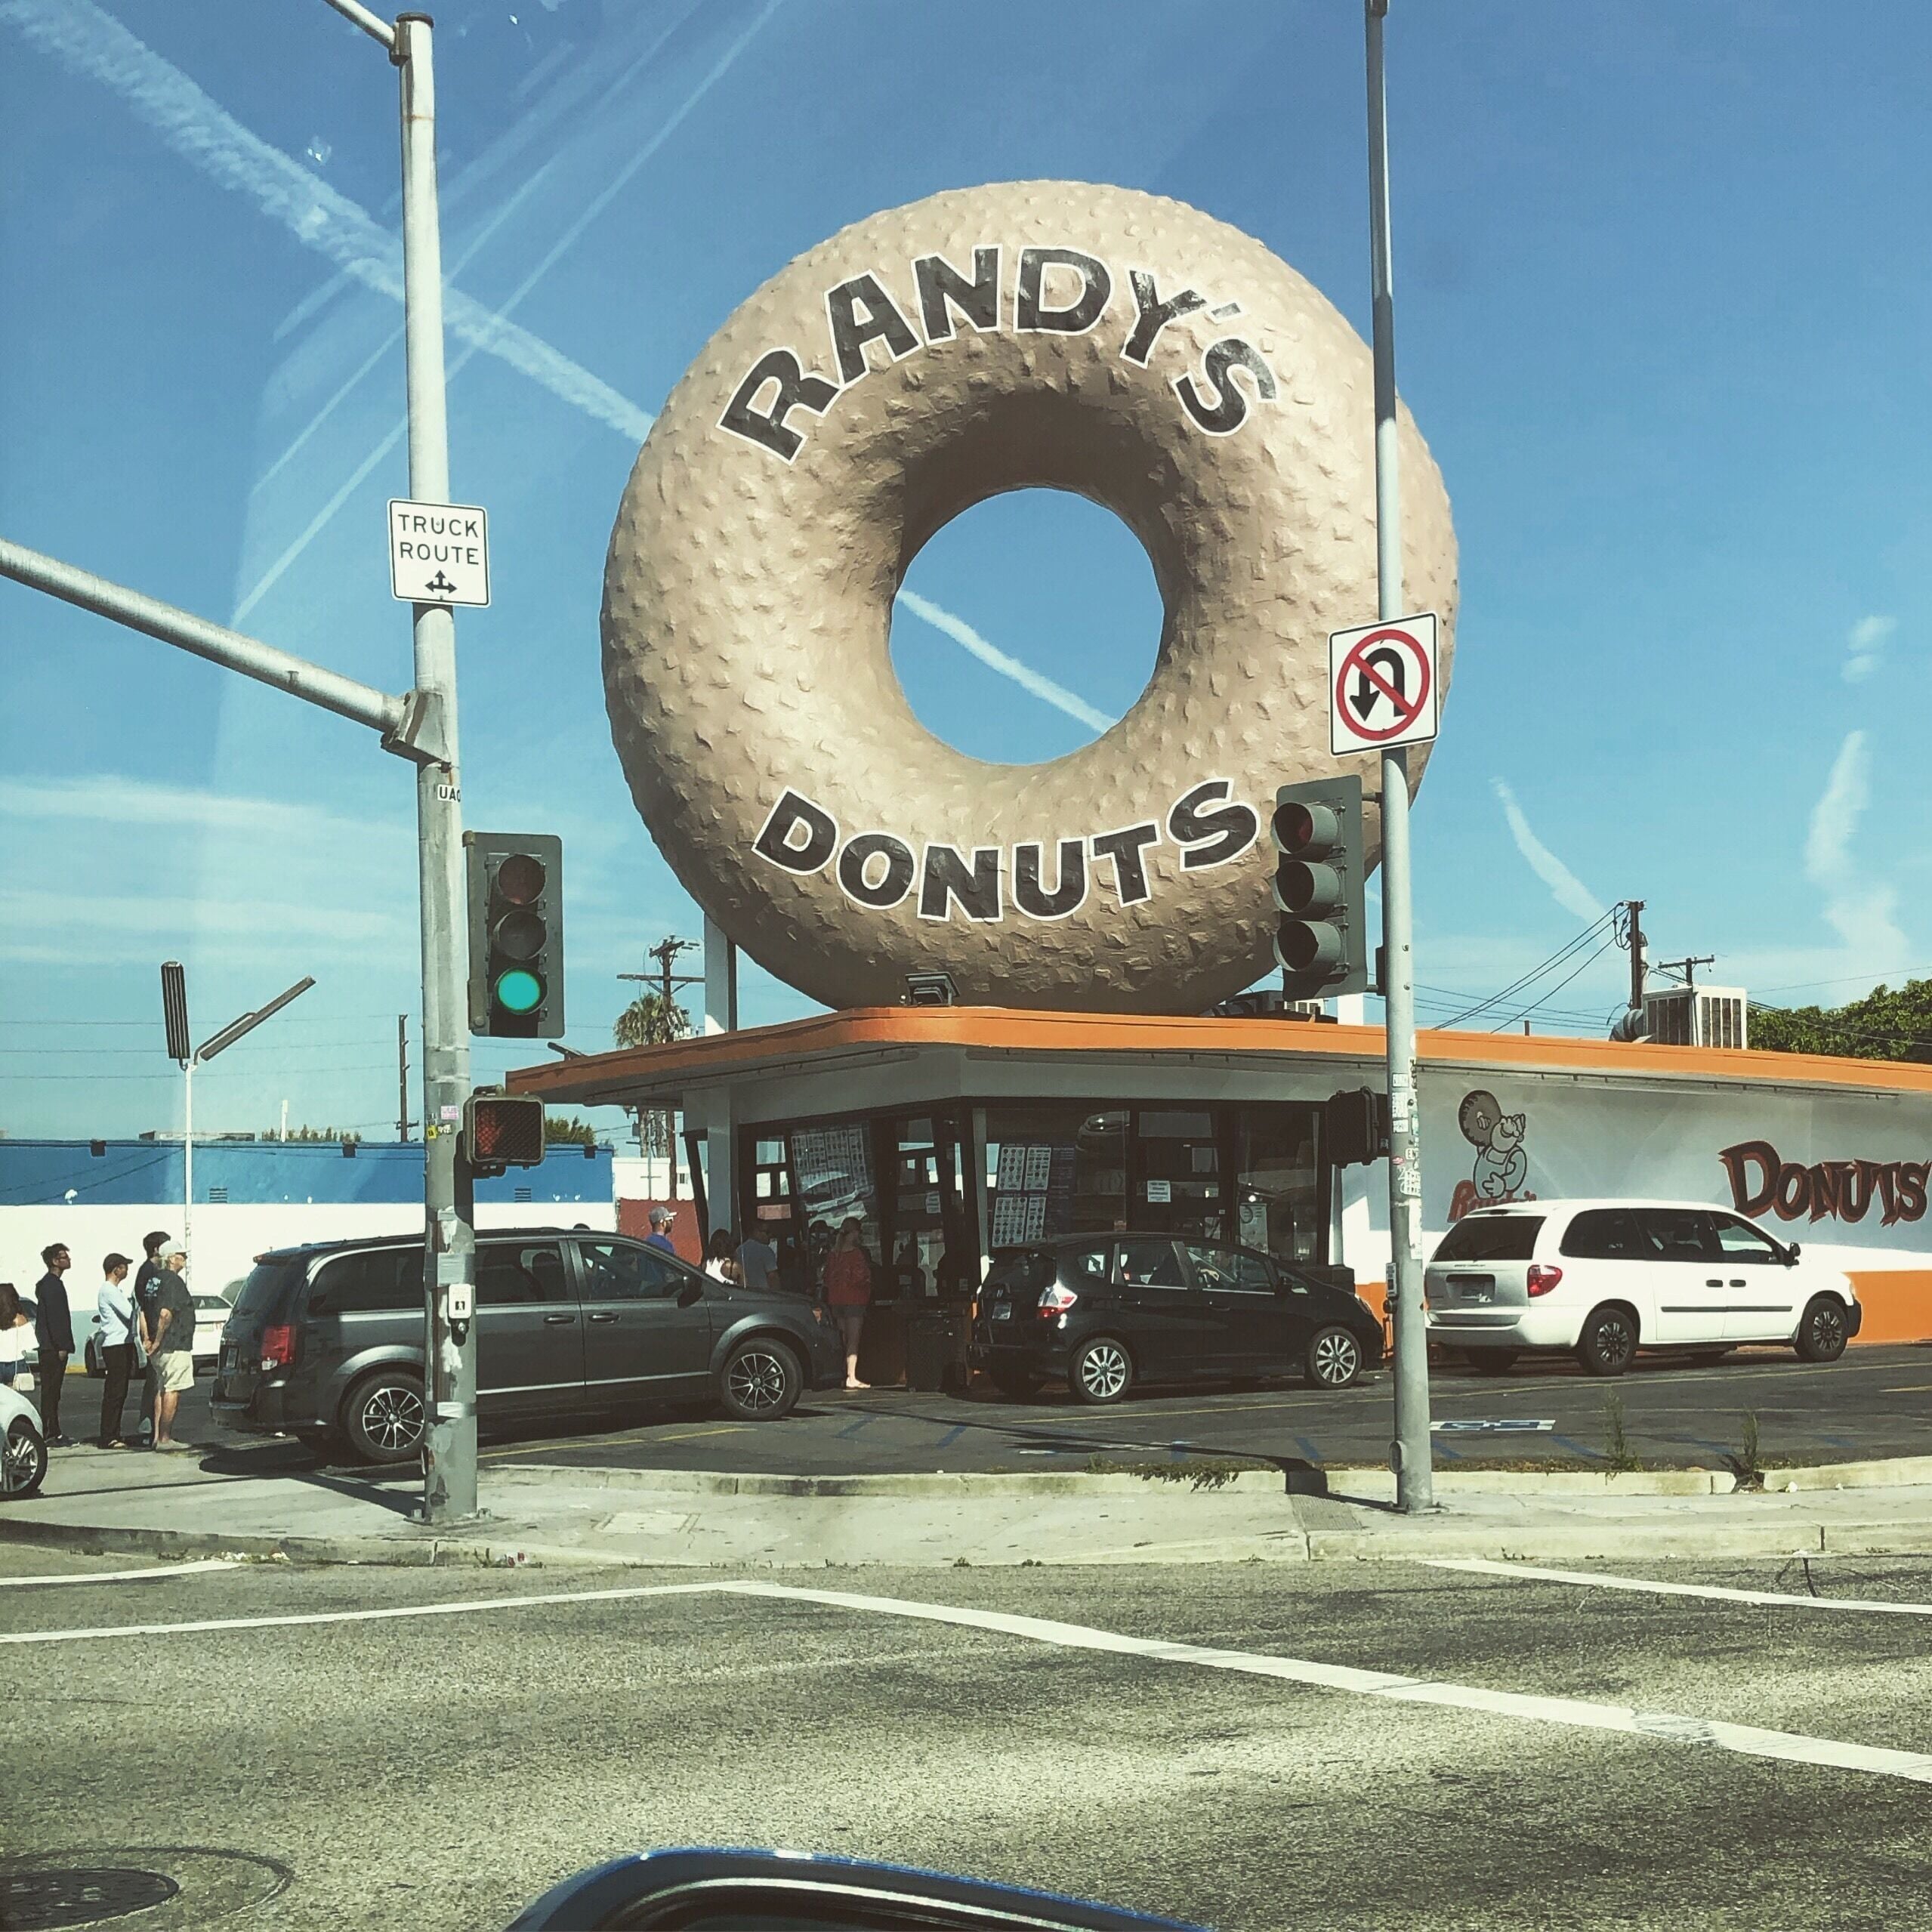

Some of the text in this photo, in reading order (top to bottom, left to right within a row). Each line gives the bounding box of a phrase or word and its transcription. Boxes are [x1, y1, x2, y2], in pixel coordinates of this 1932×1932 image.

[715, 243, 1278, 465] RANDY'S
[397, 514, 479, 539] TRUCK
[400, 541, 480, 566] ROUTE
[751, 777, 1261, 922] DONUTS
[1718, 1140, 1932, 1227] DONUTS
